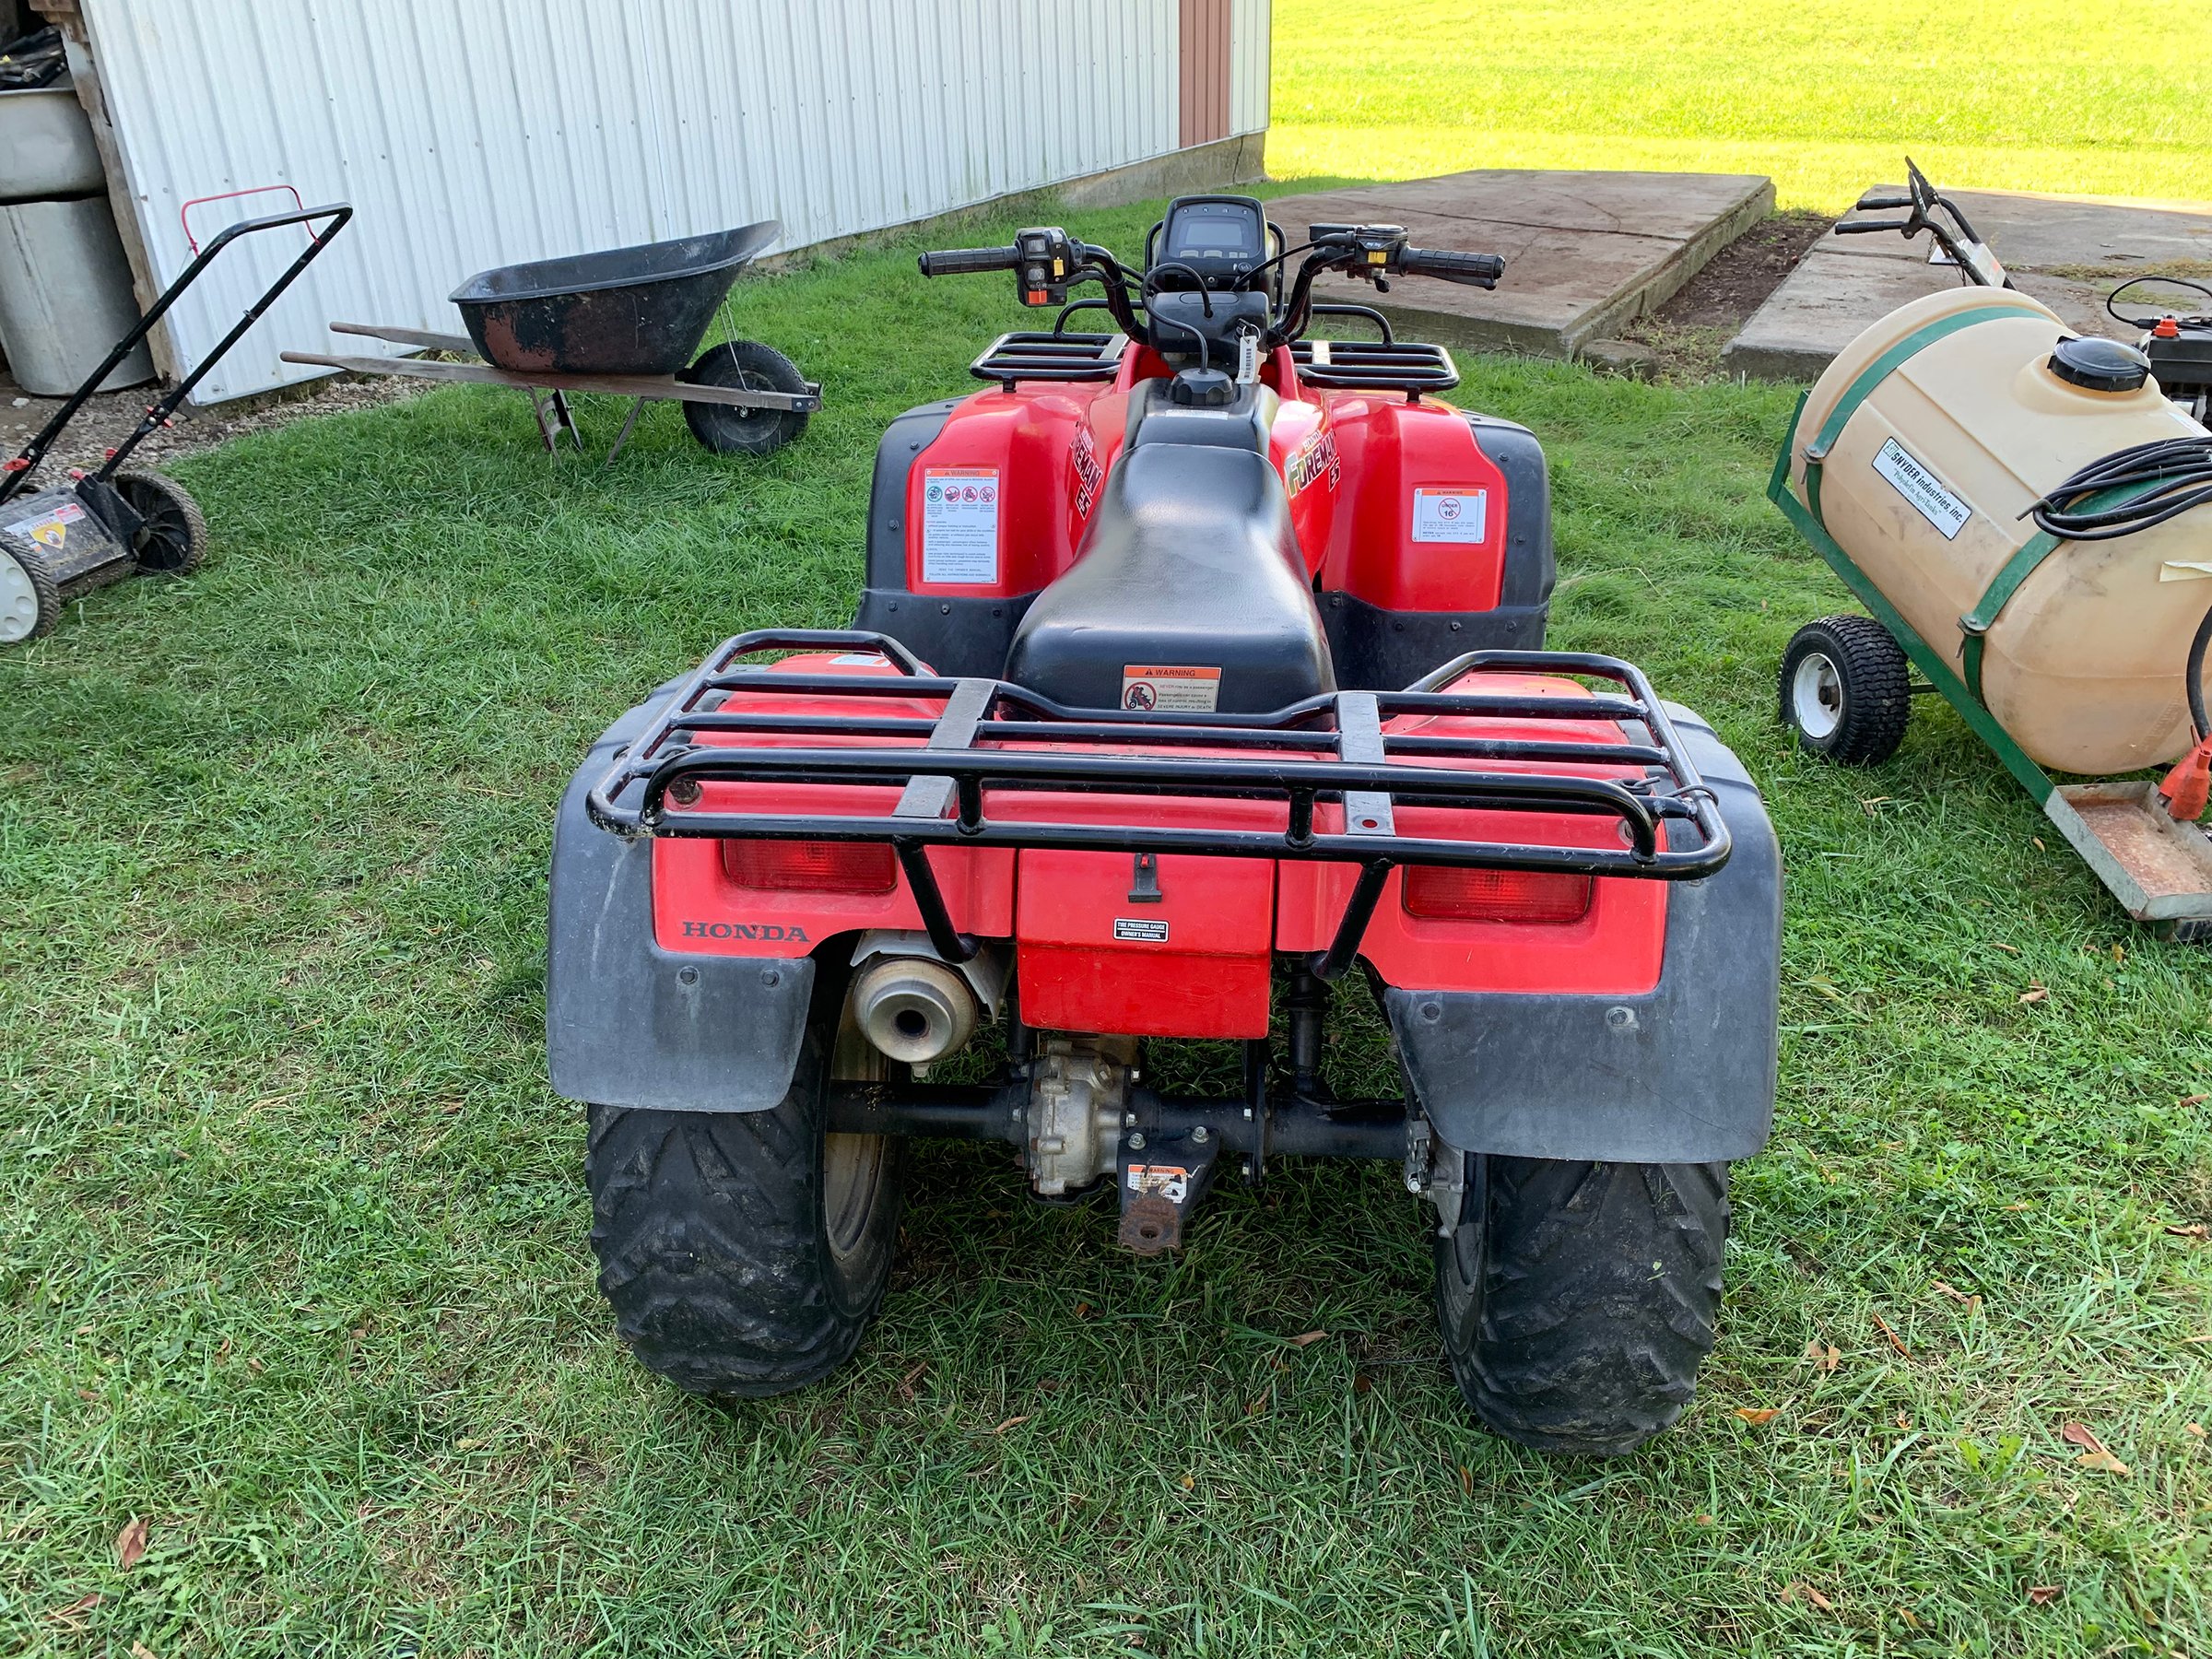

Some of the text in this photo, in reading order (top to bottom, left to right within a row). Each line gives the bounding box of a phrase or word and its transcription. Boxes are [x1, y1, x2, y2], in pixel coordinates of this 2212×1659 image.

[1284, 428, 1337, 499] FOREMAN
[1329, 456, 1341, 492] ES
[1890, 452, 1920, 480] SNYDER
[1916, 476, 1951, 512] industries,
[1948, 506, 1963, 524] inc.
[1155, 669, 1195, 677] WARNING
[682, 921, 810, 943] HONDA
